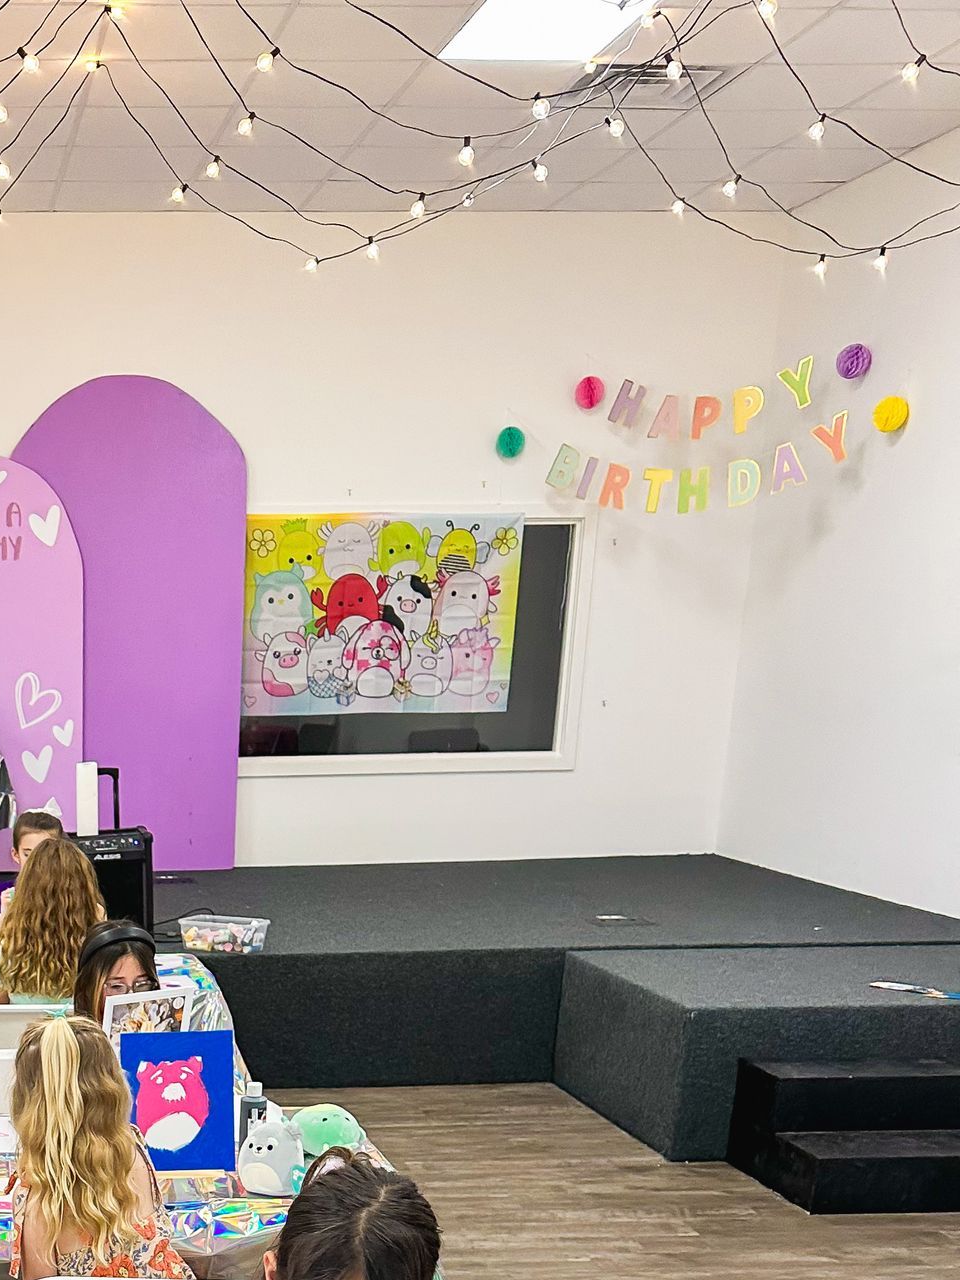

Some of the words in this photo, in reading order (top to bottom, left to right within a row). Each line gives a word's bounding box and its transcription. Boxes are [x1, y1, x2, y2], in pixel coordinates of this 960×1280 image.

[607, 355, 814, 440] HAPPY
[544, 409, 849, 514] BIRTHDAY
[6, 502, 22, 528] A
